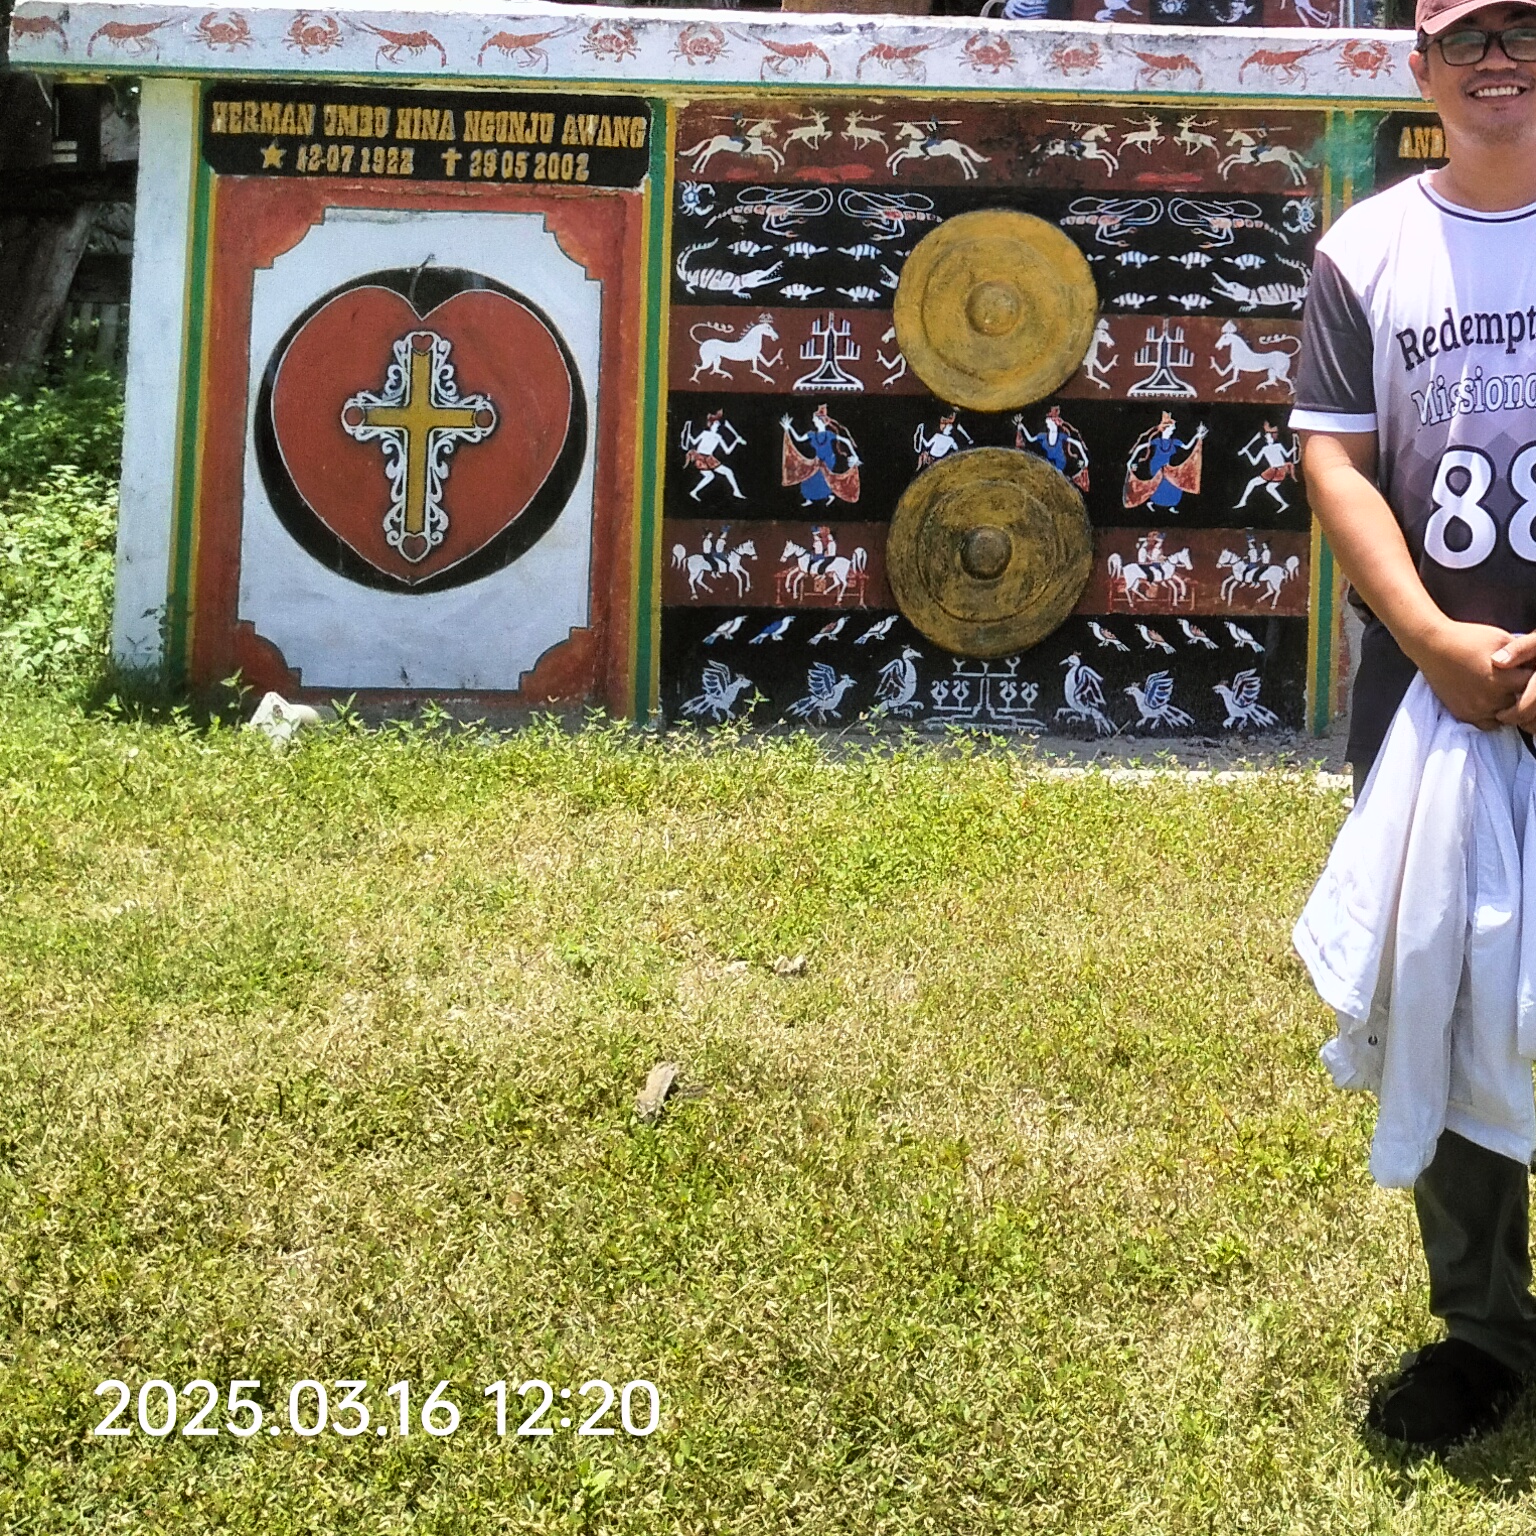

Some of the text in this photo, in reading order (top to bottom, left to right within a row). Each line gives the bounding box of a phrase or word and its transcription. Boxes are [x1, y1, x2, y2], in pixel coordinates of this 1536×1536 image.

[211, 100, 316, 136] HERMAN
[395, 106, 456, 141] HINA
[463, 110, 555, 145] NGUNJU
[561, 113, 648, 149] AWANG
